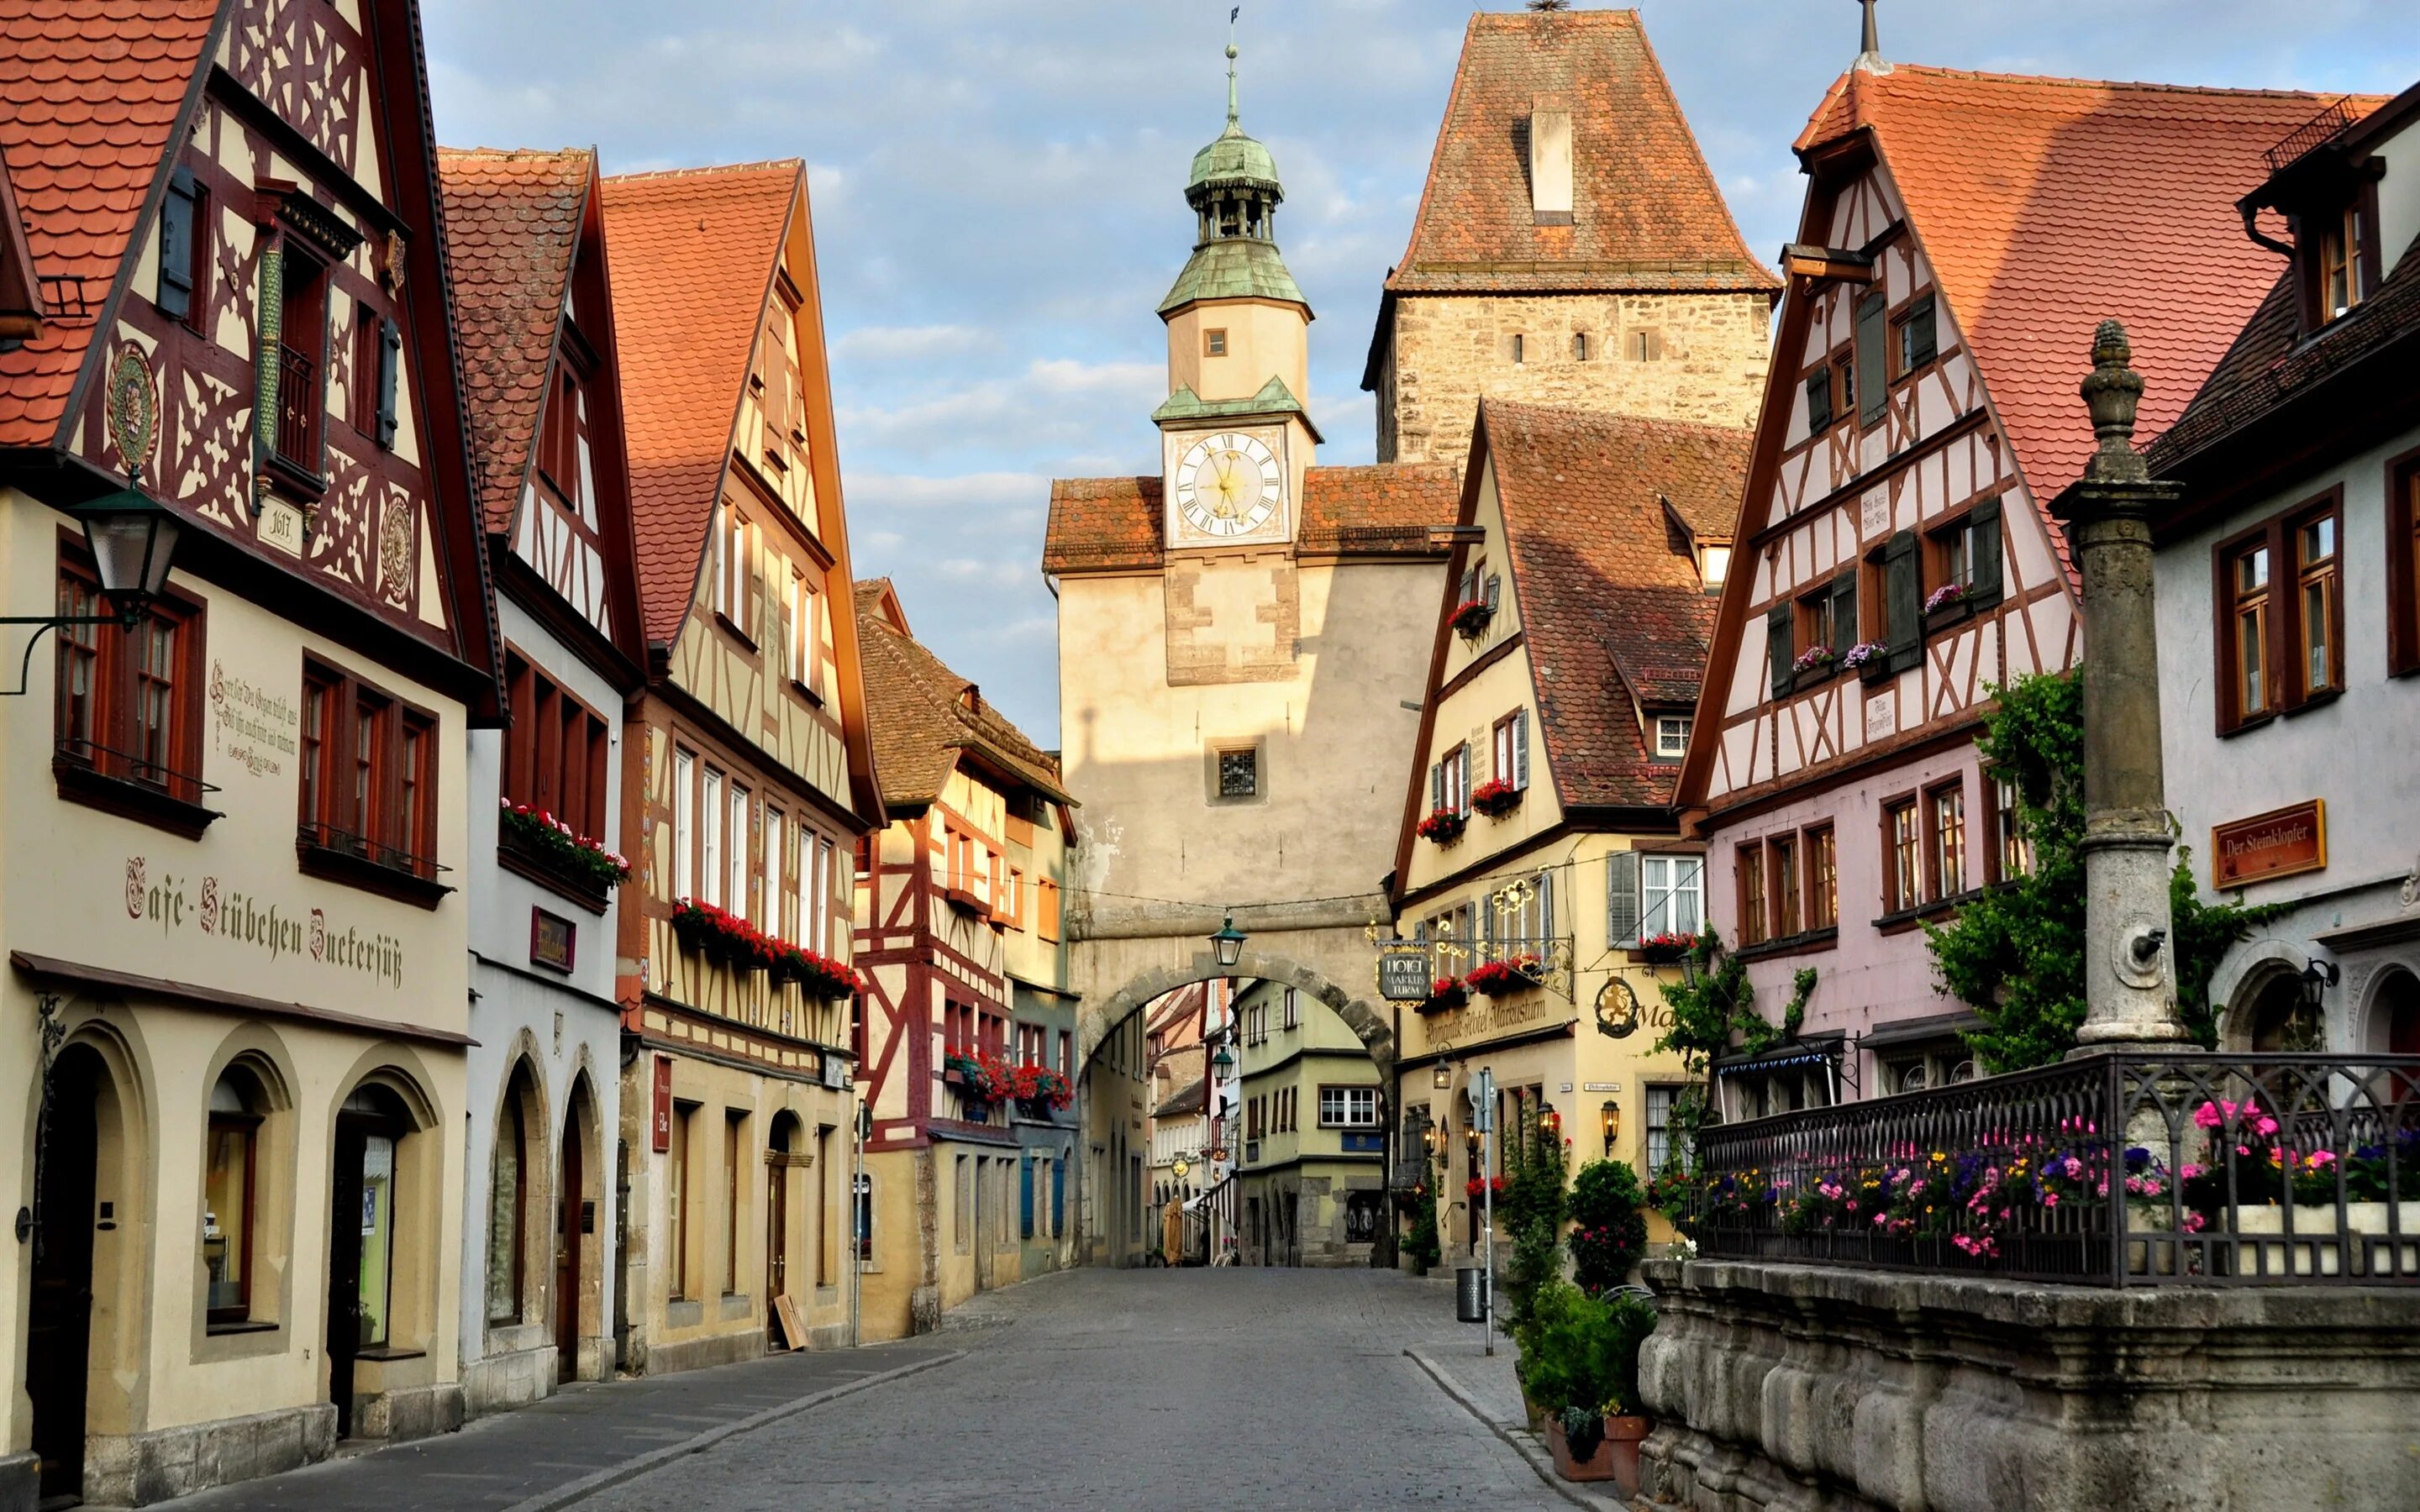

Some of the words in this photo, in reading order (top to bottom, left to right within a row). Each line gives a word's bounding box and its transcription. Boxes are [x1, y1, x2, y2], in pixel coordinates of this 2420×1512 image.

[269, 509, 292, 538] 1617
[2227, 839, 2245, 857] Der
[2246, 822, 2308, 852] Steinklopfer
[1392, 985, 1420, 995] TURM
[1489, 998, 1546, 1032] Markusturm
